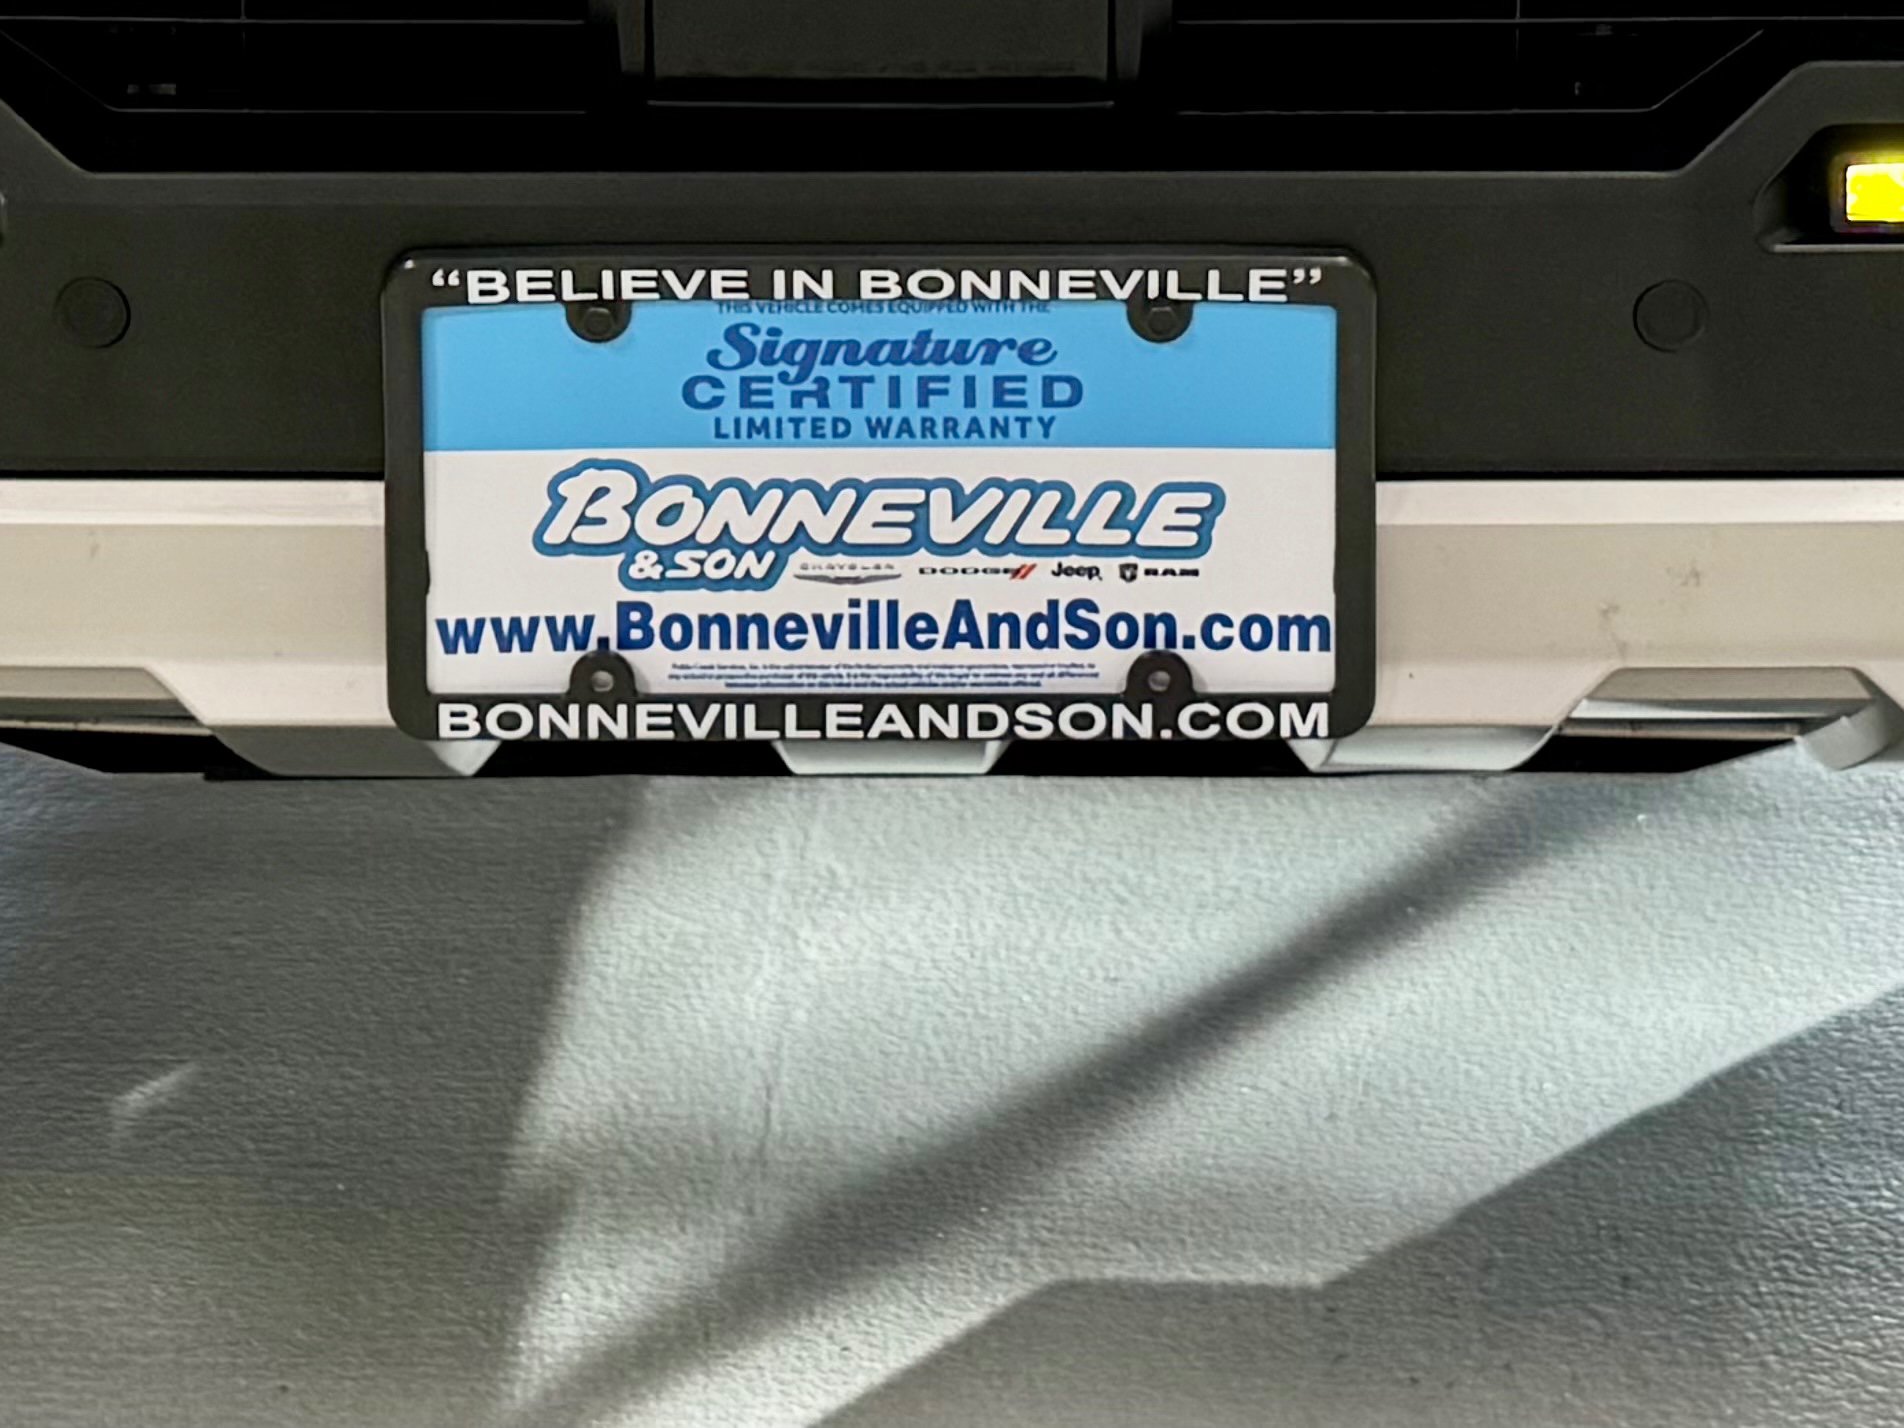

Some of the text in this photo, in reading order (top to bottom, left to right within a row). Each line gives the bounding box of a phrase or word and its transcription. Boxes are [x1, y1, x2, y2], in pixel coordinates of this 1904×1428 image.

[772, 269, 834, 301] IN
[755, 300, 825, 314] VEHICLE
[827, 300, 885, 314] COMES
[705, 321, 1059, 386] Signature
[681, 374, 1085, 411] CERTIFIED
[713, 415, 1057, 441] LIMITED WARRANTY
[539, 465, 1214, 549] BONNEVILLE
[1051, 561, 1099, 578] Jeep
[434, 597, 1332, 653] www.BonnevilleAndSon.com
[436, 701, 1330, 740] BONNEVILLEANDSON.COM
